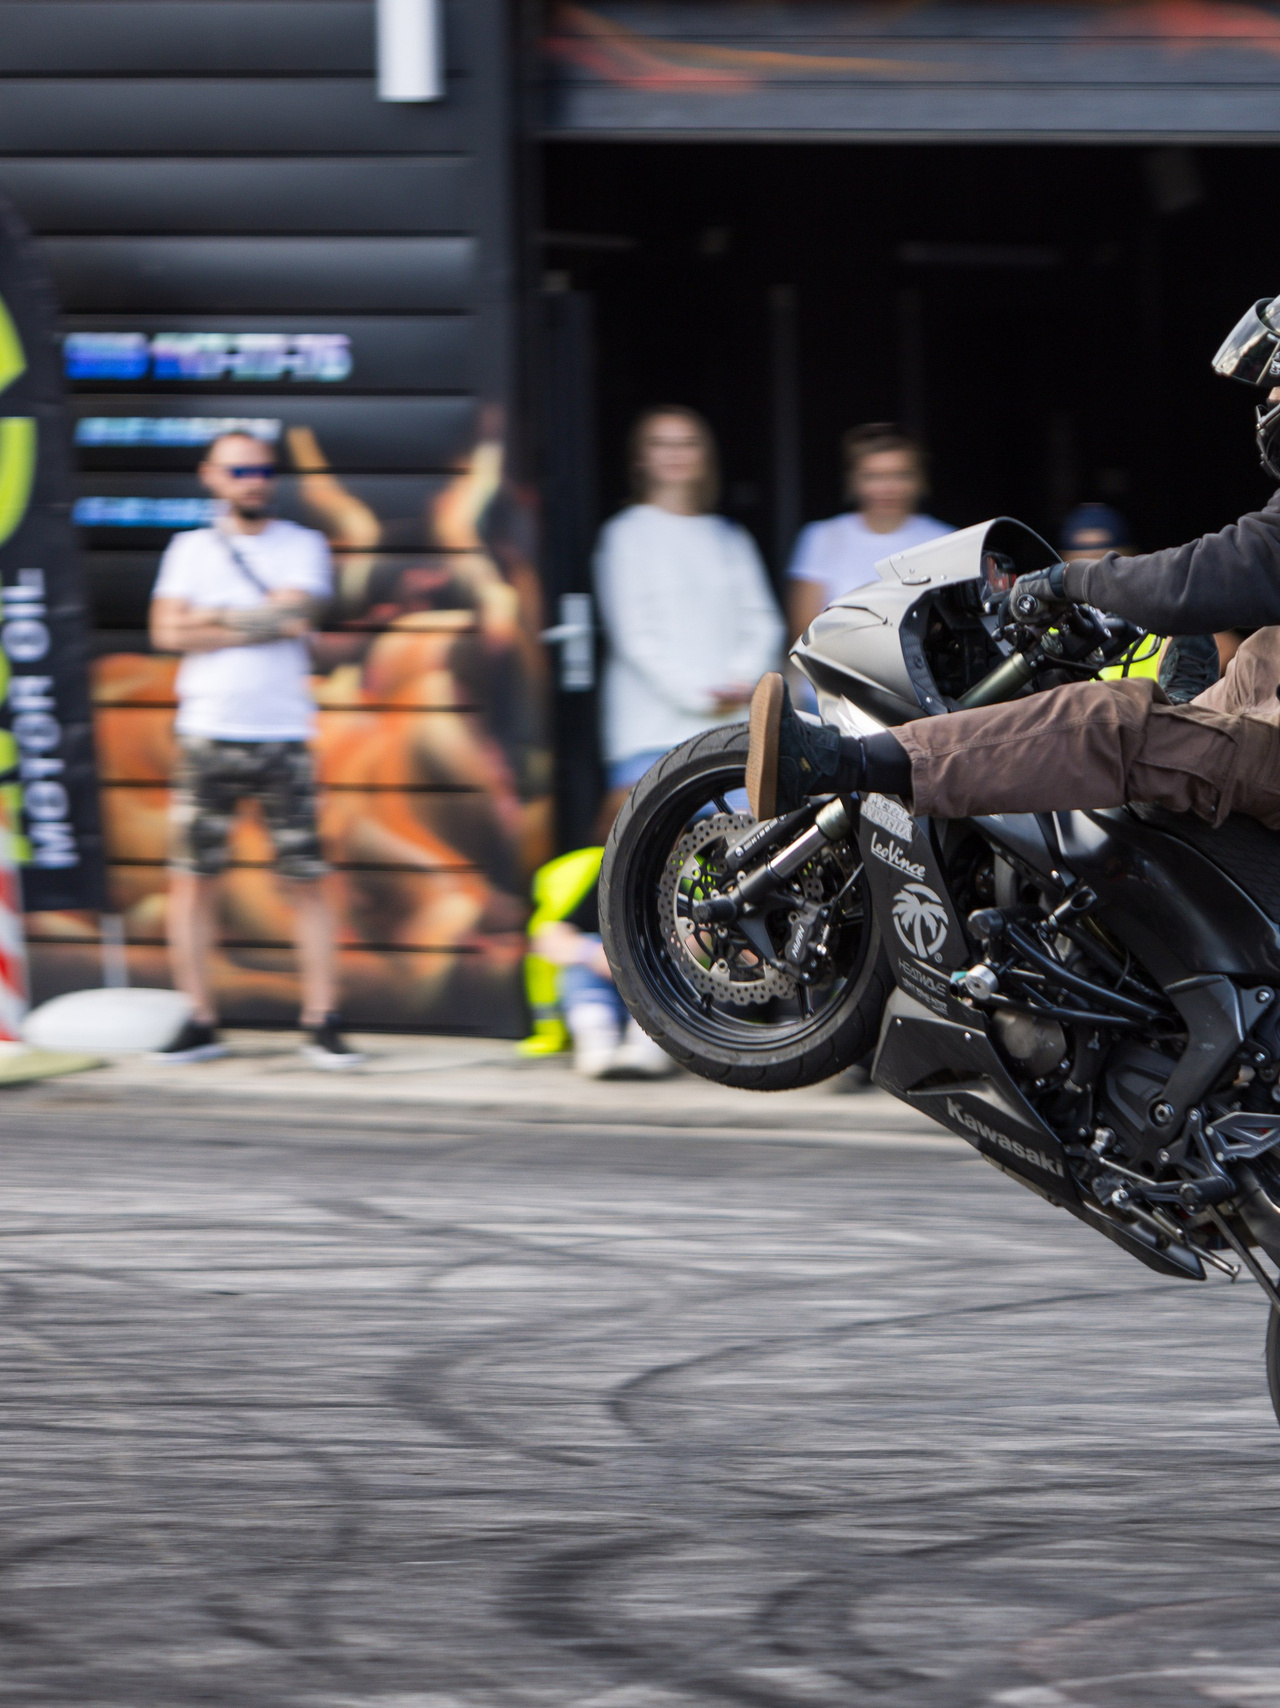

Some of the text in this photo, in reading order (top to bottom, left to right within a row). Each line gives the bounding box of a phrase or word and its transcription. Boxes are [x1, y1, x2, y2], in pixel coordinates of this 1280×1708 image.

[0, 567, 51, 662] OIL
[8, 675, 79, 868] MOTOR
[871, 831, 925, 882] LeoVince
[946, 1096, 1065, 1178] Kawasaki
